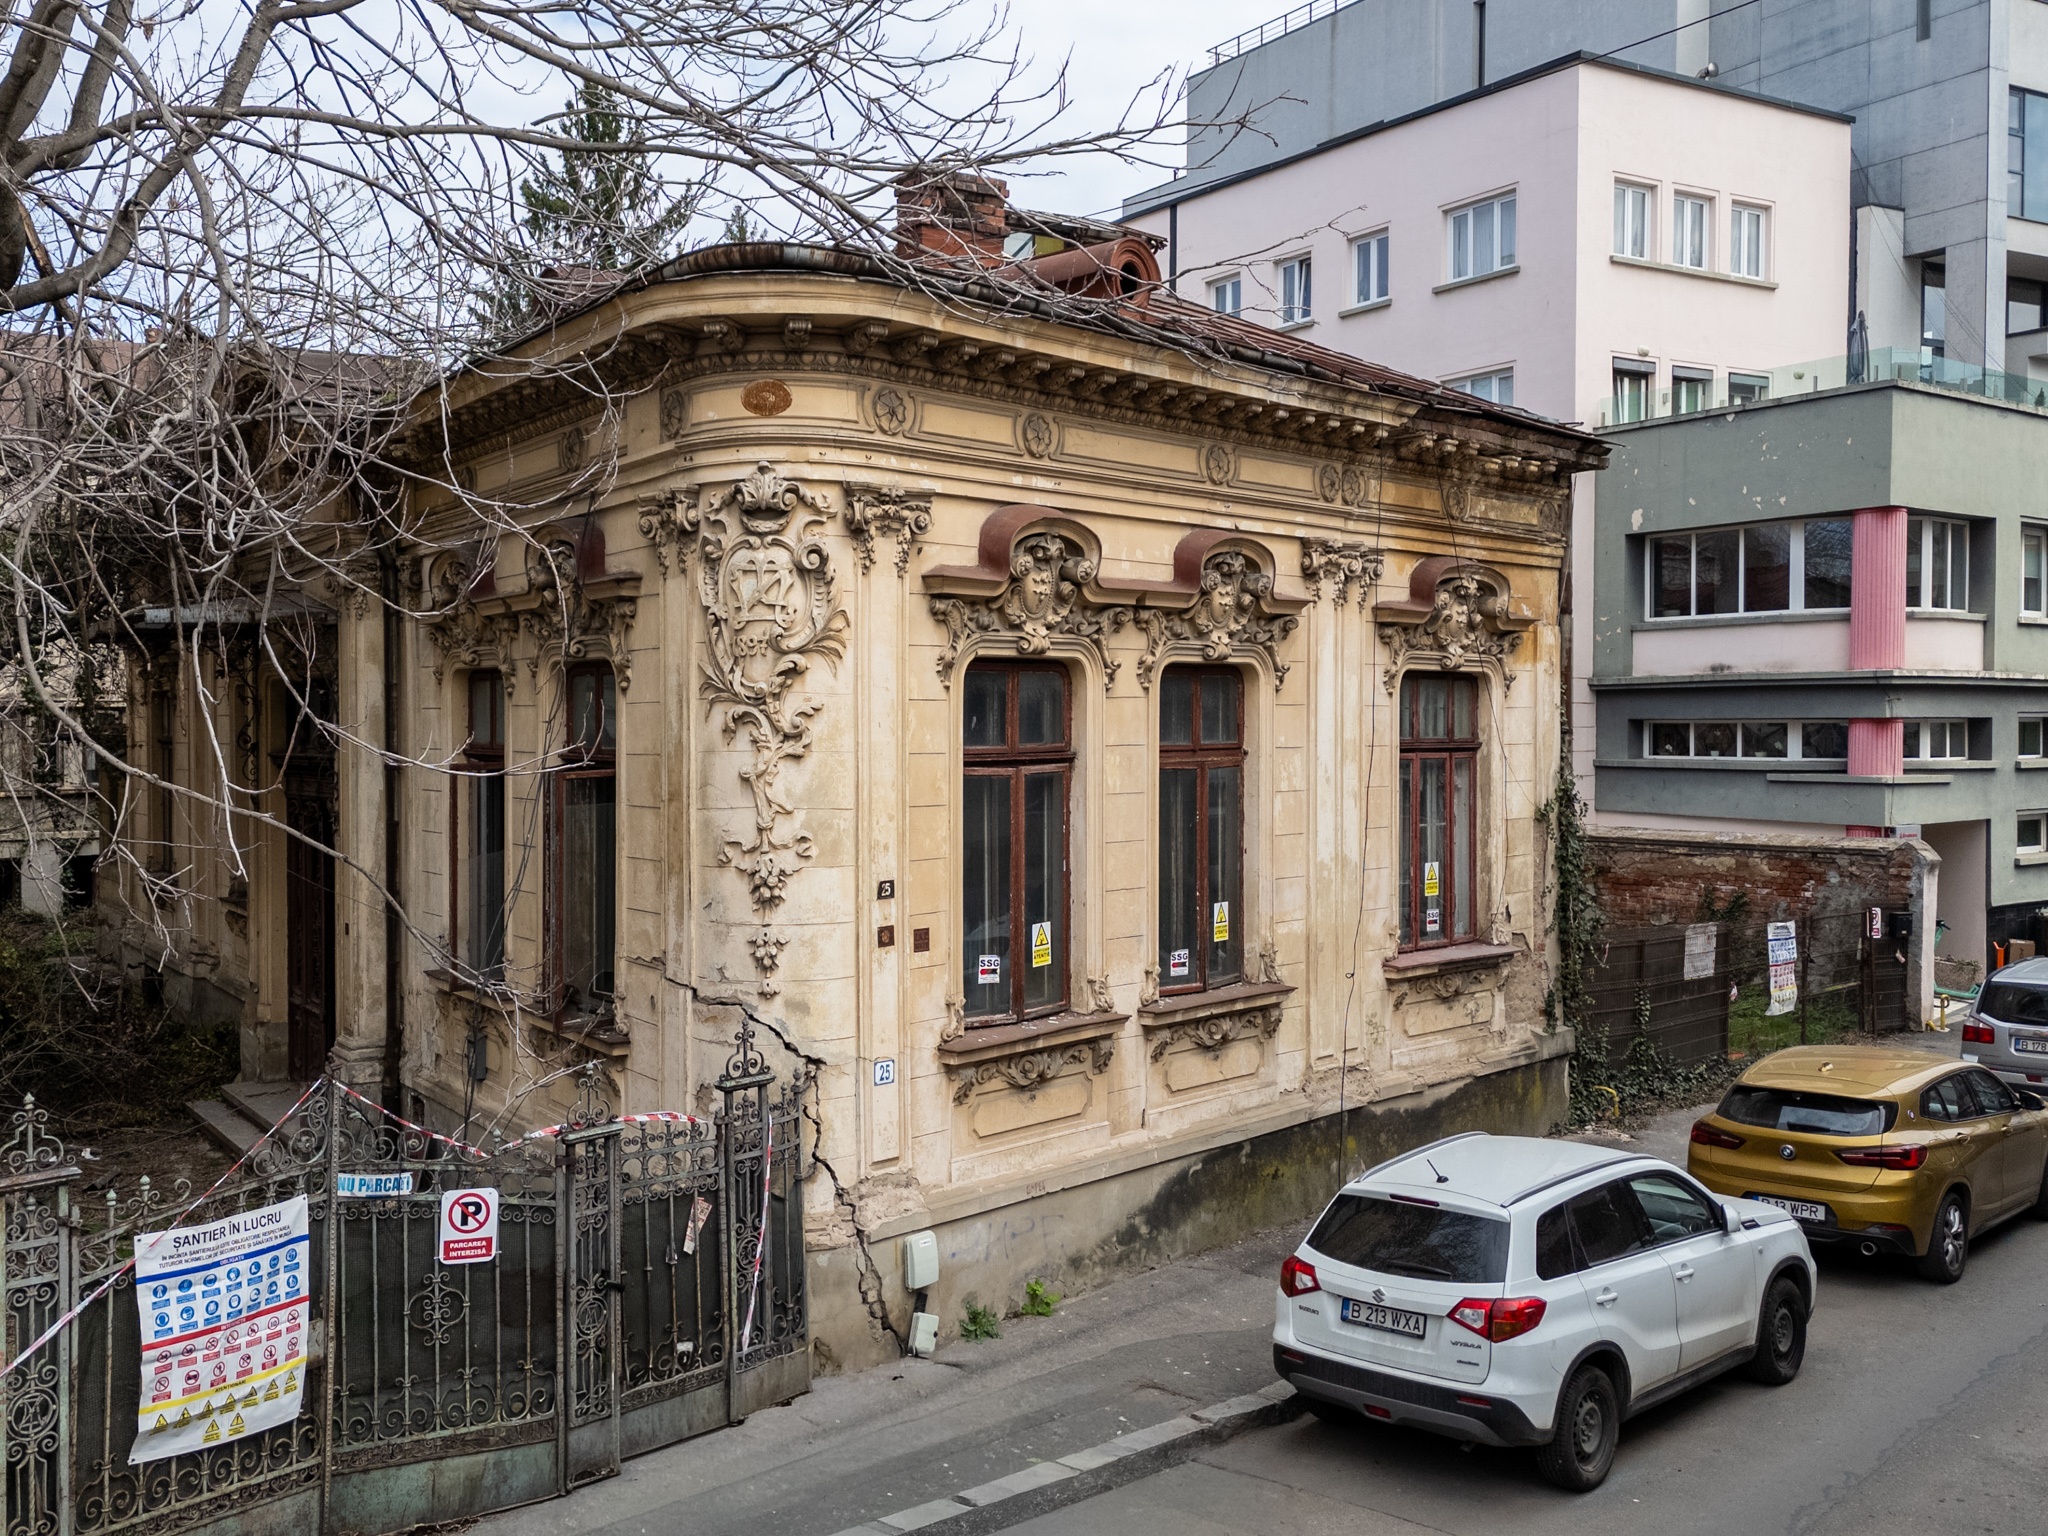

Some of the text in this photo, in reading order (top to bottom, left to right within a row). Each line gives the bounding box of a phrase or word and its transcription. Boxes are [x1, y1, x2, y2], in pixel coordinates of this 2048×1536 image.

[881, 882, 891, 897] 25
[980, 959, 1000, 968] SSG
[1171, 953, 1188, 961] SSG
[2021, 1041, 2047, 1051] B 178
[879, 1064, 891, 1081] 25
[338, 1176, 355, 1192] NU
[1790, 1202, 1819, 1218] WPR
[228, 1221, 241, 1236] ÎN
[244, 1211, 282, 1232] LUCRU
[450, 1240, 487, 1249] PARCAREA
[1351, 1306, 1361, 1319] B
[1365, 1307, 1387, 1325] 213
[1391, 1311, 1421, 1333] WXA
